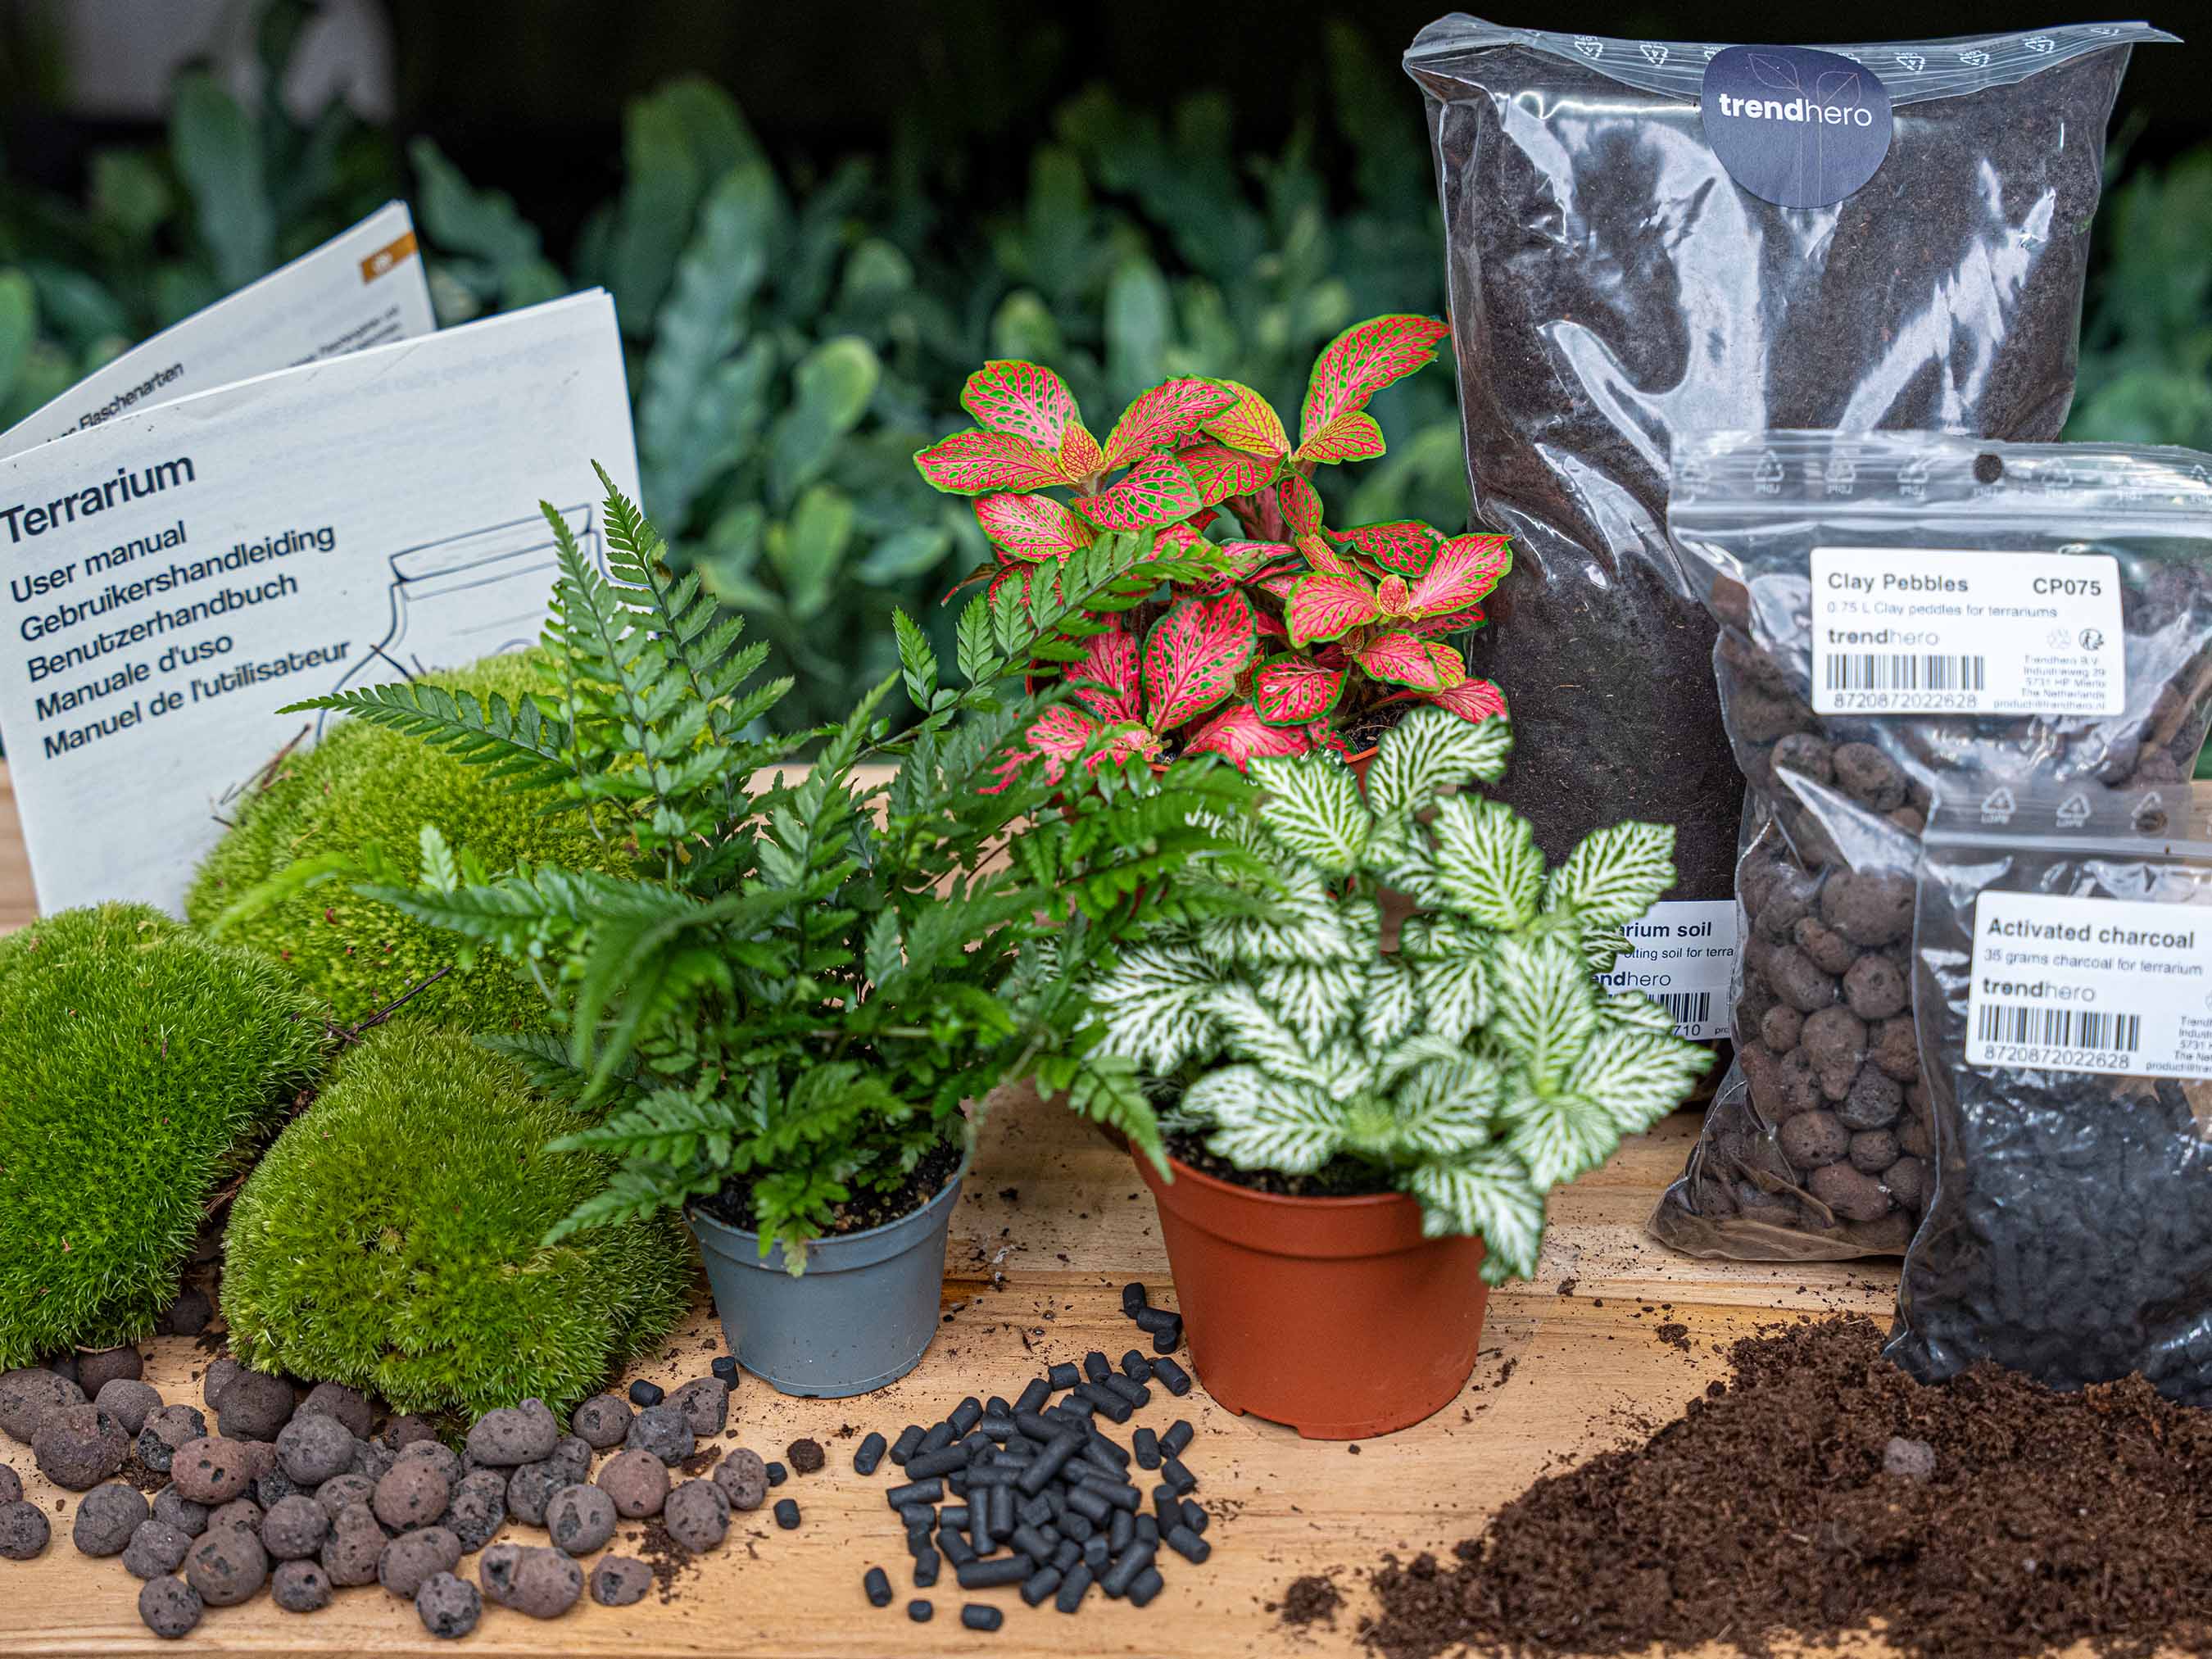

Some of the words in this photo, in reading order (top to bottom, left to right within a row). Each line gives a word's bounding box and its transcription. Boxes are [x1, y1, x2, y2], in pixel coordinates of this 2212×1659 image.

[1719, 93, 1873, 126] trendhero
[0, 456, 197, 544] Terrarium
[11, 563, 77, 603] User
[84, 519, 188, 577] manual
[20, 525, 337, 642] Gebruikershandleiding
[1828, 572, 1874, 594] Clay
[1883, 573, 1969, 592] Pebbles
[2033, 578, 2101, 596] CP075
[1874, 601, 1904, 615] Clay
[1967, 604, 1984, 615] for
[1989, 605, 2058, 618] terrariums
[27, 573, 298, 682] Benutzerhandbuch
[1828, 628, 1939, 646] trendhero
[34, 662, 151, 722] Manuale
[158, 634, 233, 673] d'uso
[43, 701, 143, 759] Manuel
[150, 691, 184, 718] de
[190, 640, 351, 703] l'utilisateur
[1834, 692, 1979, 709] 8720872022628
[1620, 922, 1670, 937] arium
[1677, 921, 1711, 937] soil
[1987, 918, 2092, 943] Activated
[2098, 926, 2196, 949] charcoal
[1624, 948, 1658, 962] otting
[1661, 947, 1683, 959] soil
[1686, 947, 1702, 958] for
[1706, 947, 1734, 958] terra
[2006, 951, 2049, 966] grams
[2052, 954, 2114, 970] charcoal
[2118, 957, 2137, 971] for
[2141, 959, 2204, 976] terrarium
[1592, 971, 1671, 986] endhero
[1983, 977, 2096, 1003] trendhero
[1983, 1045, 2130, 1070] 8720872022628
